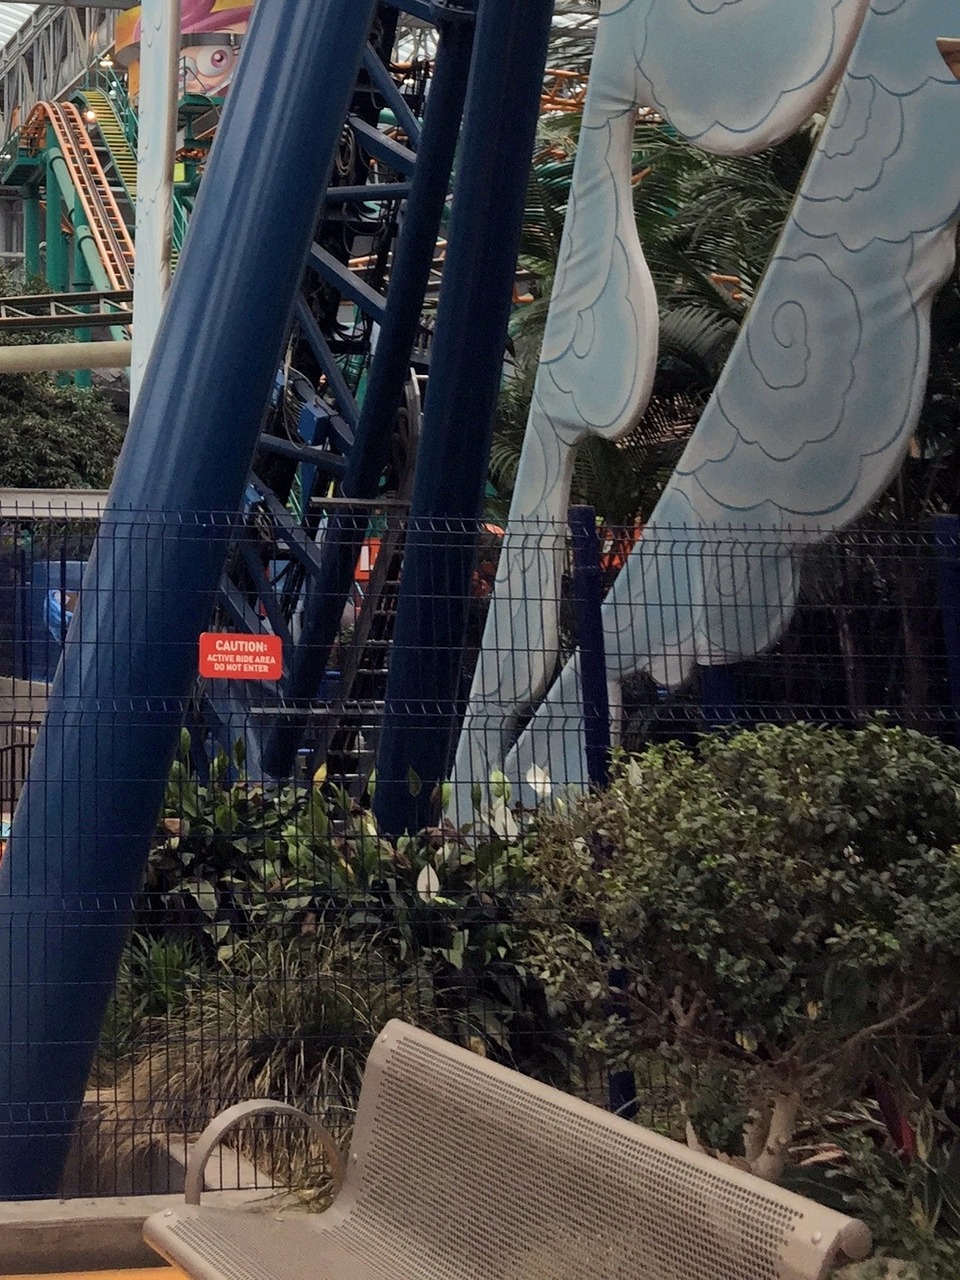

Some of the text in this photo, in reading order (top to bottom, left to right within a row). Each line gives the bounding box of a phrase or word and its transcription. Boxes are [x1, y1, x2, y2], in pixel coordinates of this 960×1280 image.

[215, 640, 268, 652] CAUTION:
[206, 654, 276, 664] ACTIVE RIDE AREA
[214, 663, 269, 673] DO NOT ENTER
